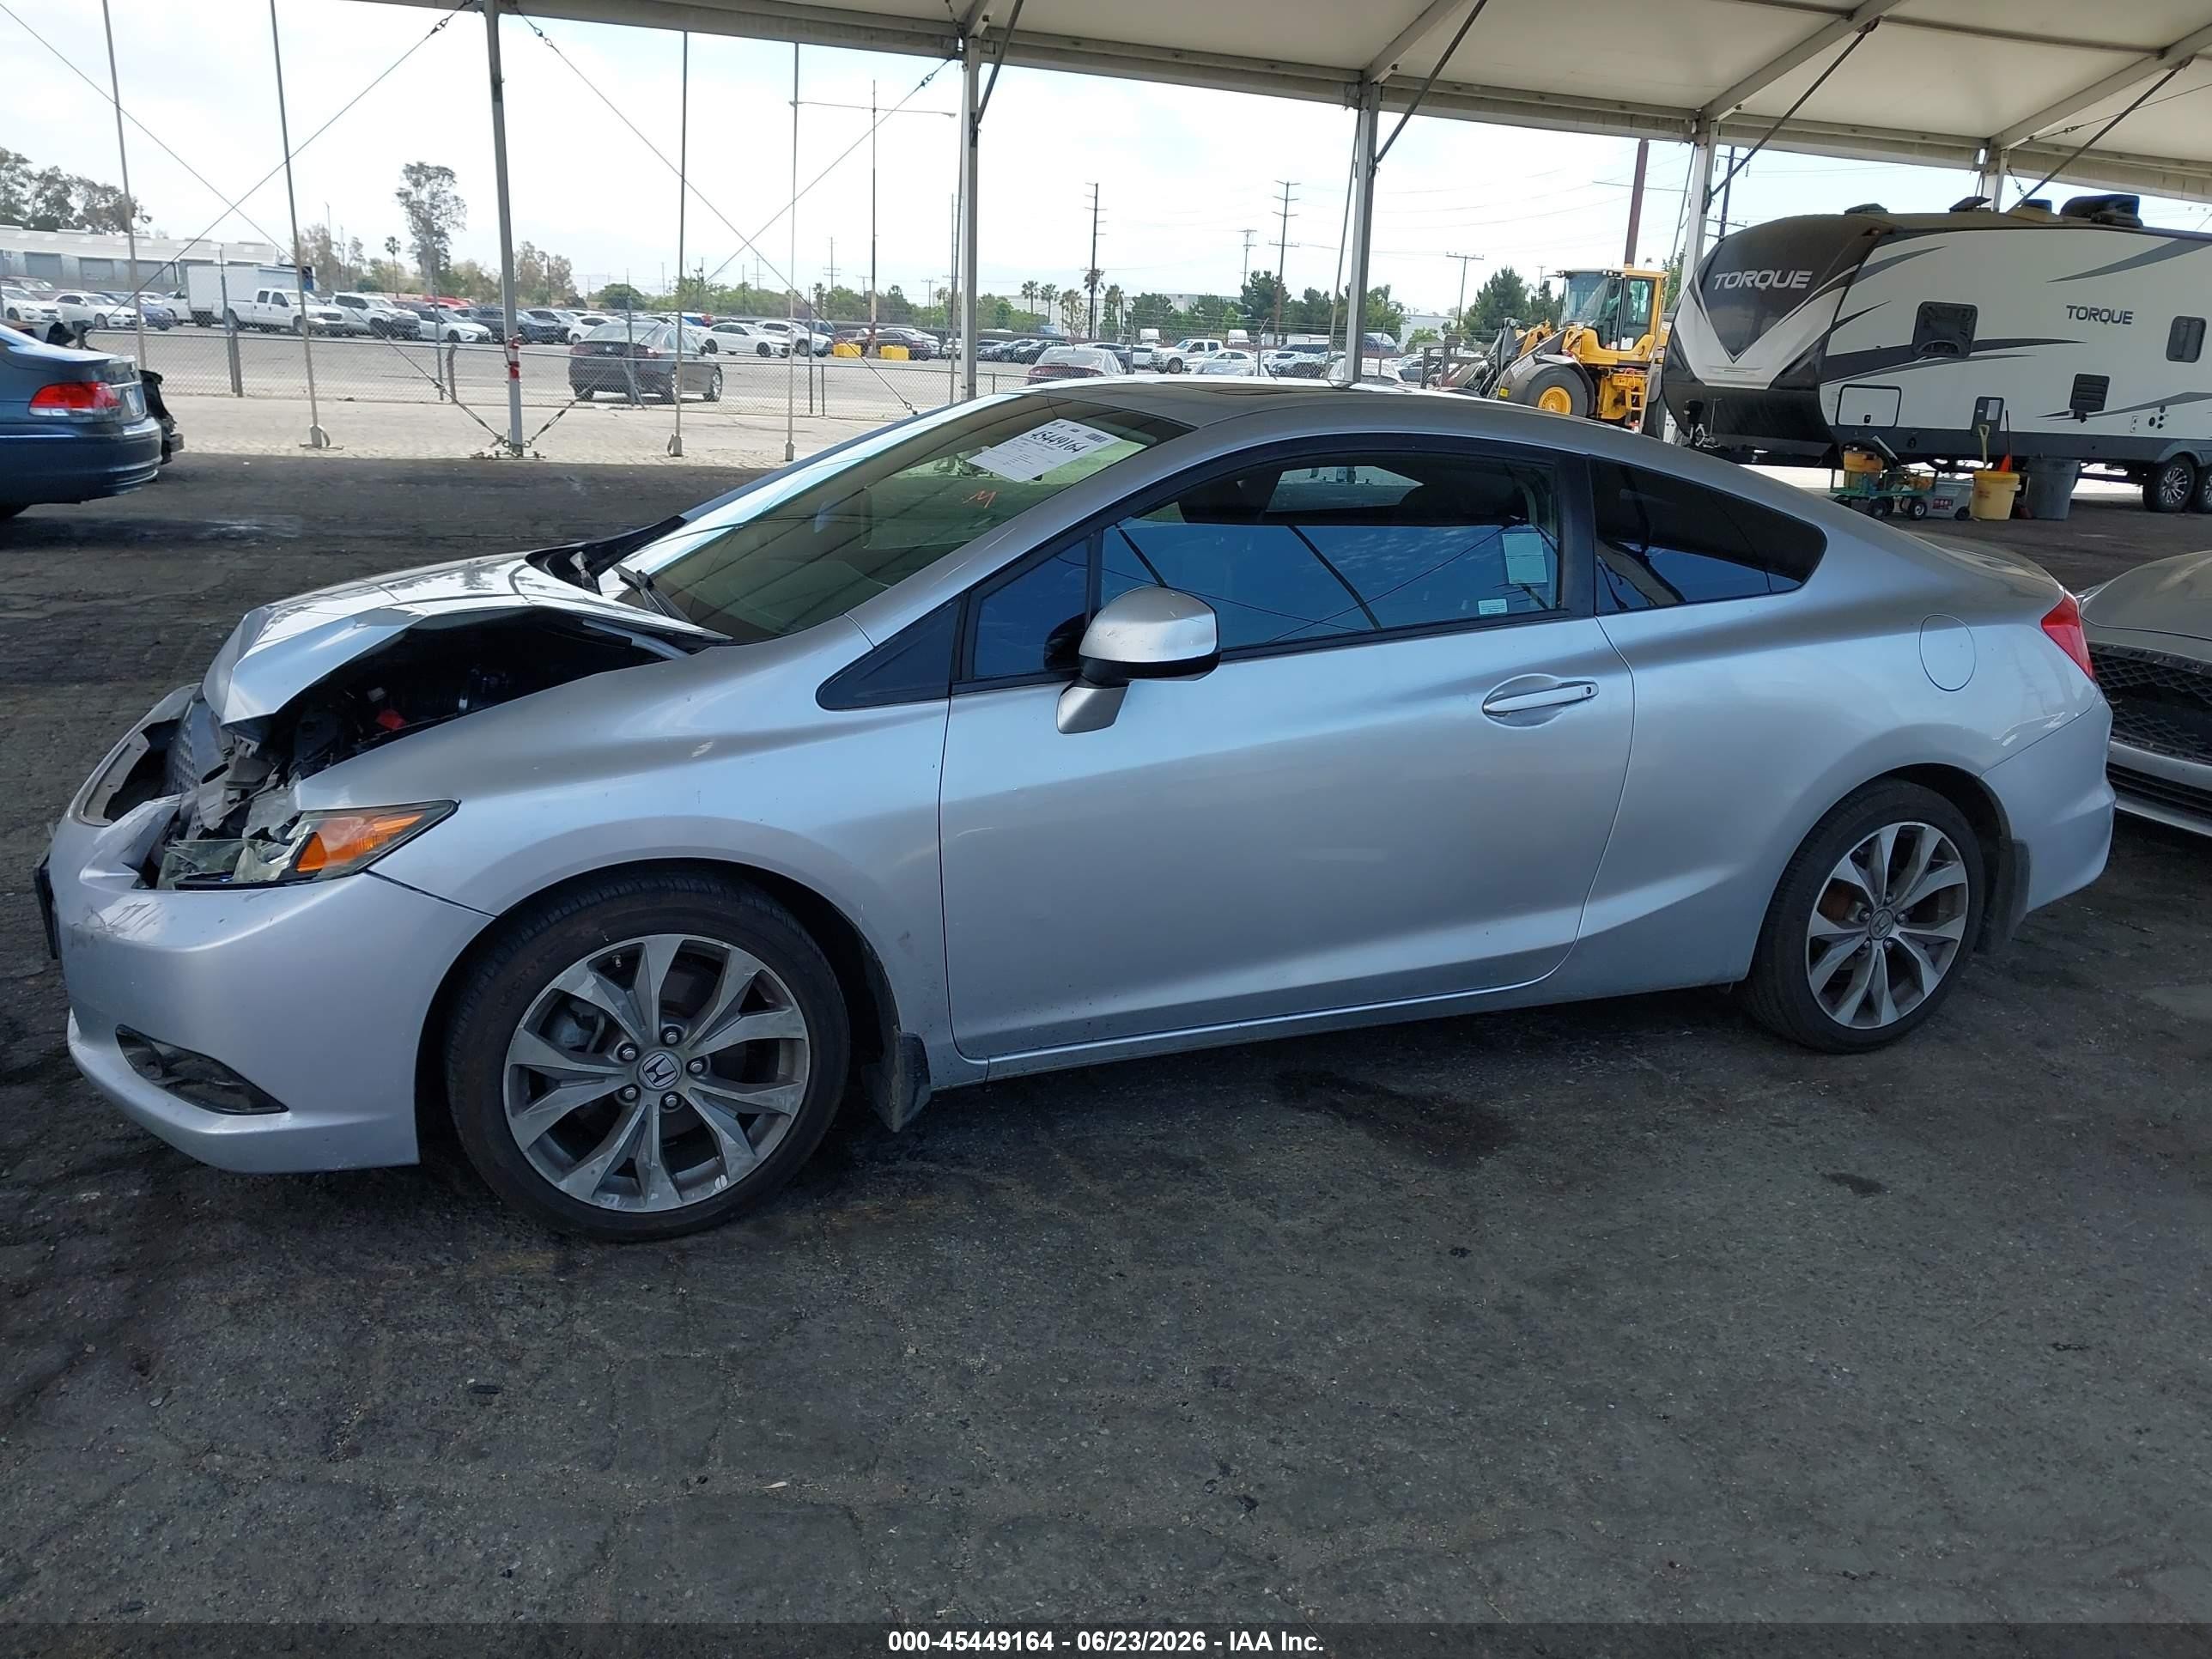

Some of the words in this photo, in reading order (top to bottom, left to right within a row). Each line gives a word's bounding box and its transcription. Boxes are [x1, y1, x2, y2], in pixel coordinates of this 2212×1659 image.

[1714, 270, 1813, 290] TORQUE
[2066, 305, 2133, 325] TORQUE
[1030, 430, 1090, 453] 45449164
